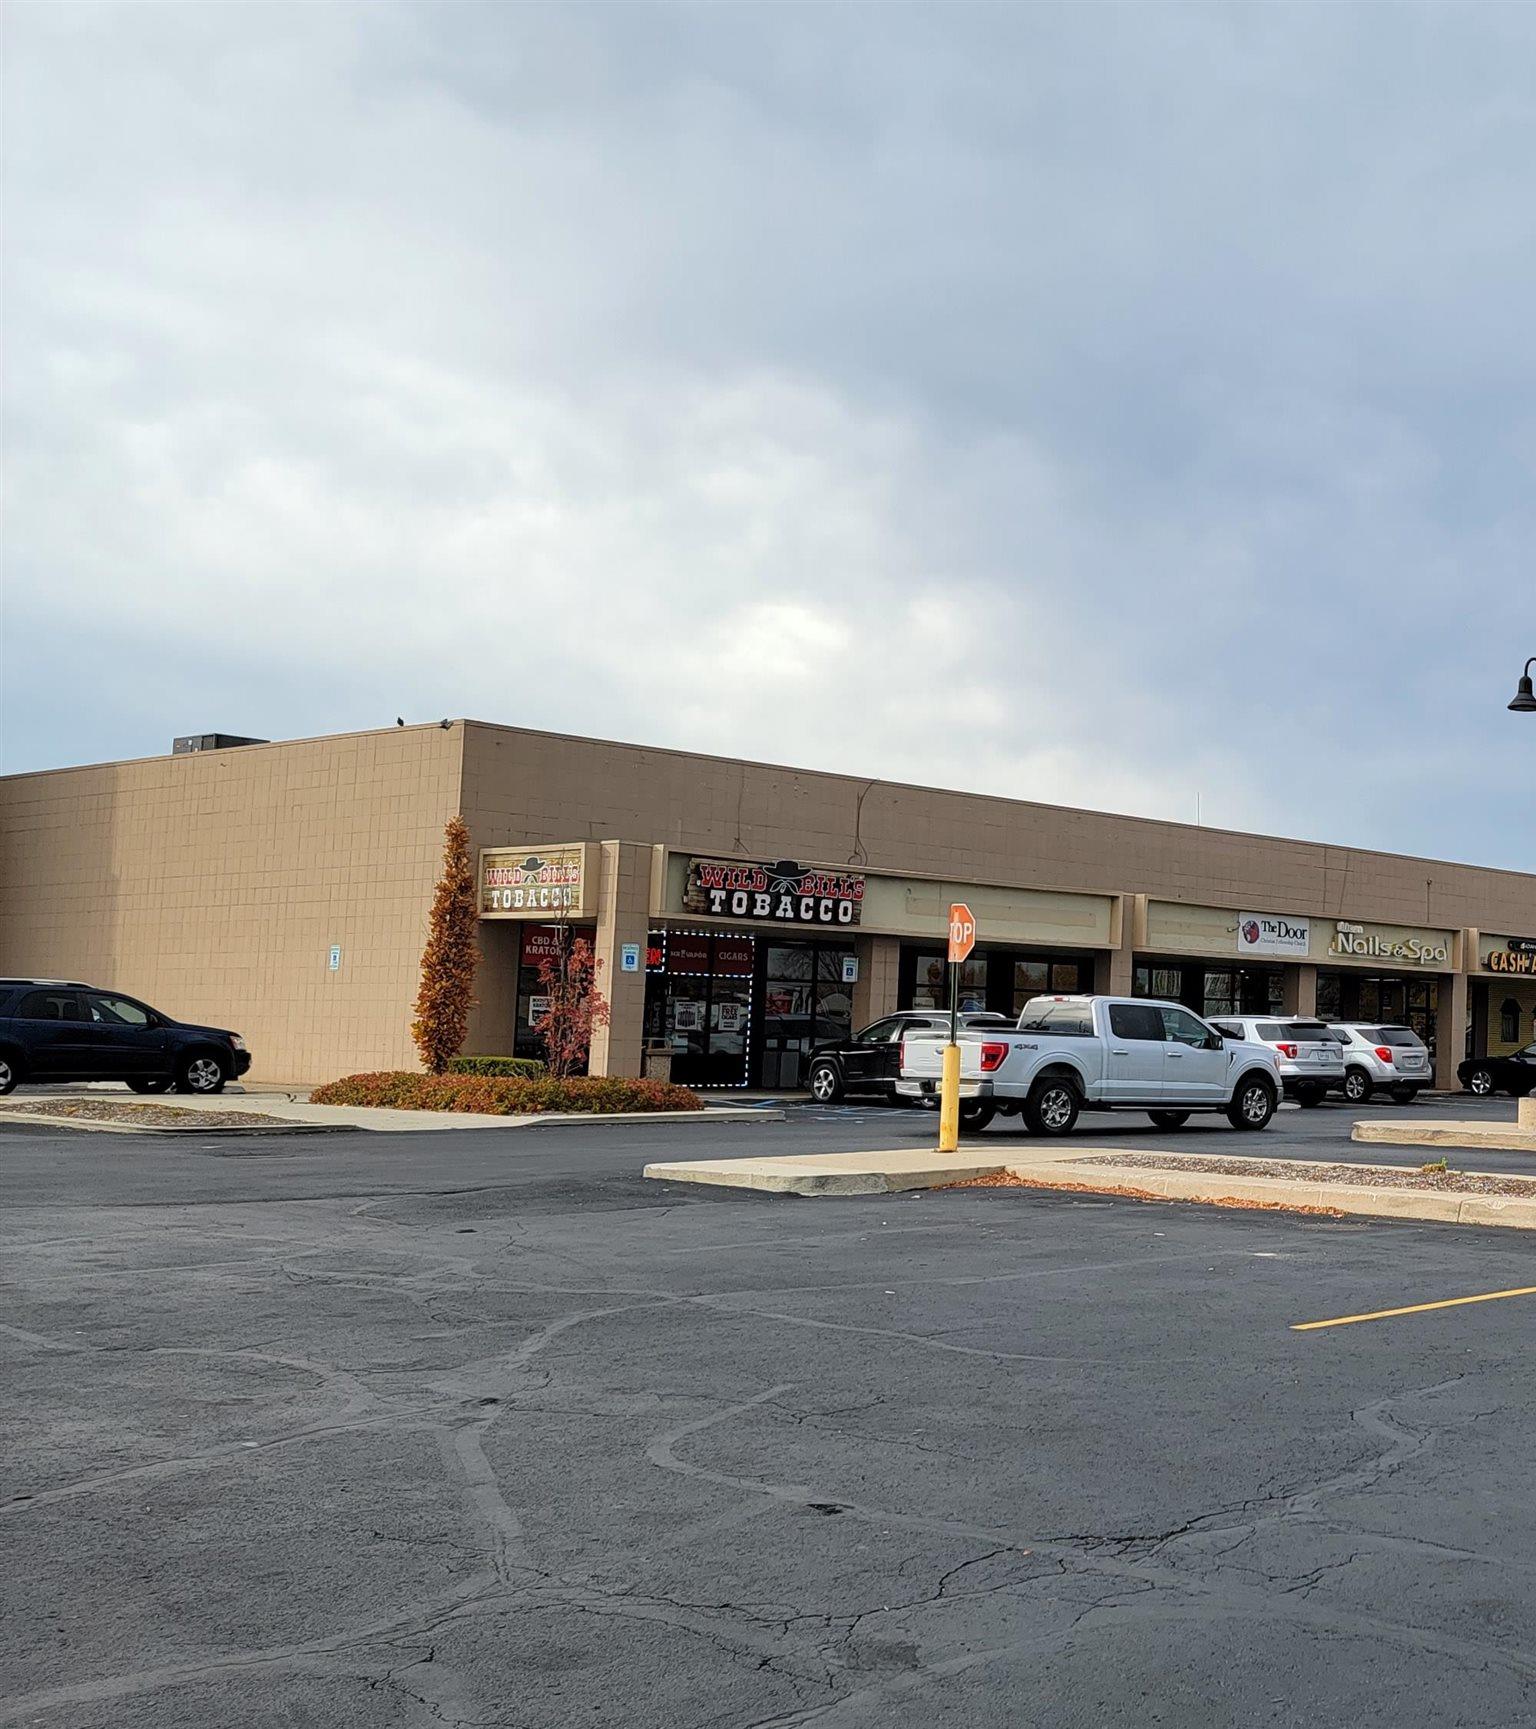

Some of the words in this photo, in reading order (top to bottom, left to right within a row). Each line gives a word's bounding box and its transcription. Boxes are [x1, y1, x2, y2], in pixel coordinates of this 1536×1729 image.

[486, 867, 523, 887] WILD
[700, 863, 768, 892] WILD
[799, 873, 866, 901] BILL'S
[491, 887, 572, 909] TOBACCO
[710, 889, 854, 923] TOBACCO
[531, 936, 550, 945] CBD
[949, 922, 972, 944] TOP
[1261, 920, 1277, 933] The
[1277, 920, 1308, 940] Door
[718, 951, 749, 961] CIGARS
[1337, 933, 1391, 956] Nails
[1394, 944, 1405, 957] &
[1407, 939, 1447, 965] Spa
[1490, 951, 1525, 972] CASH
